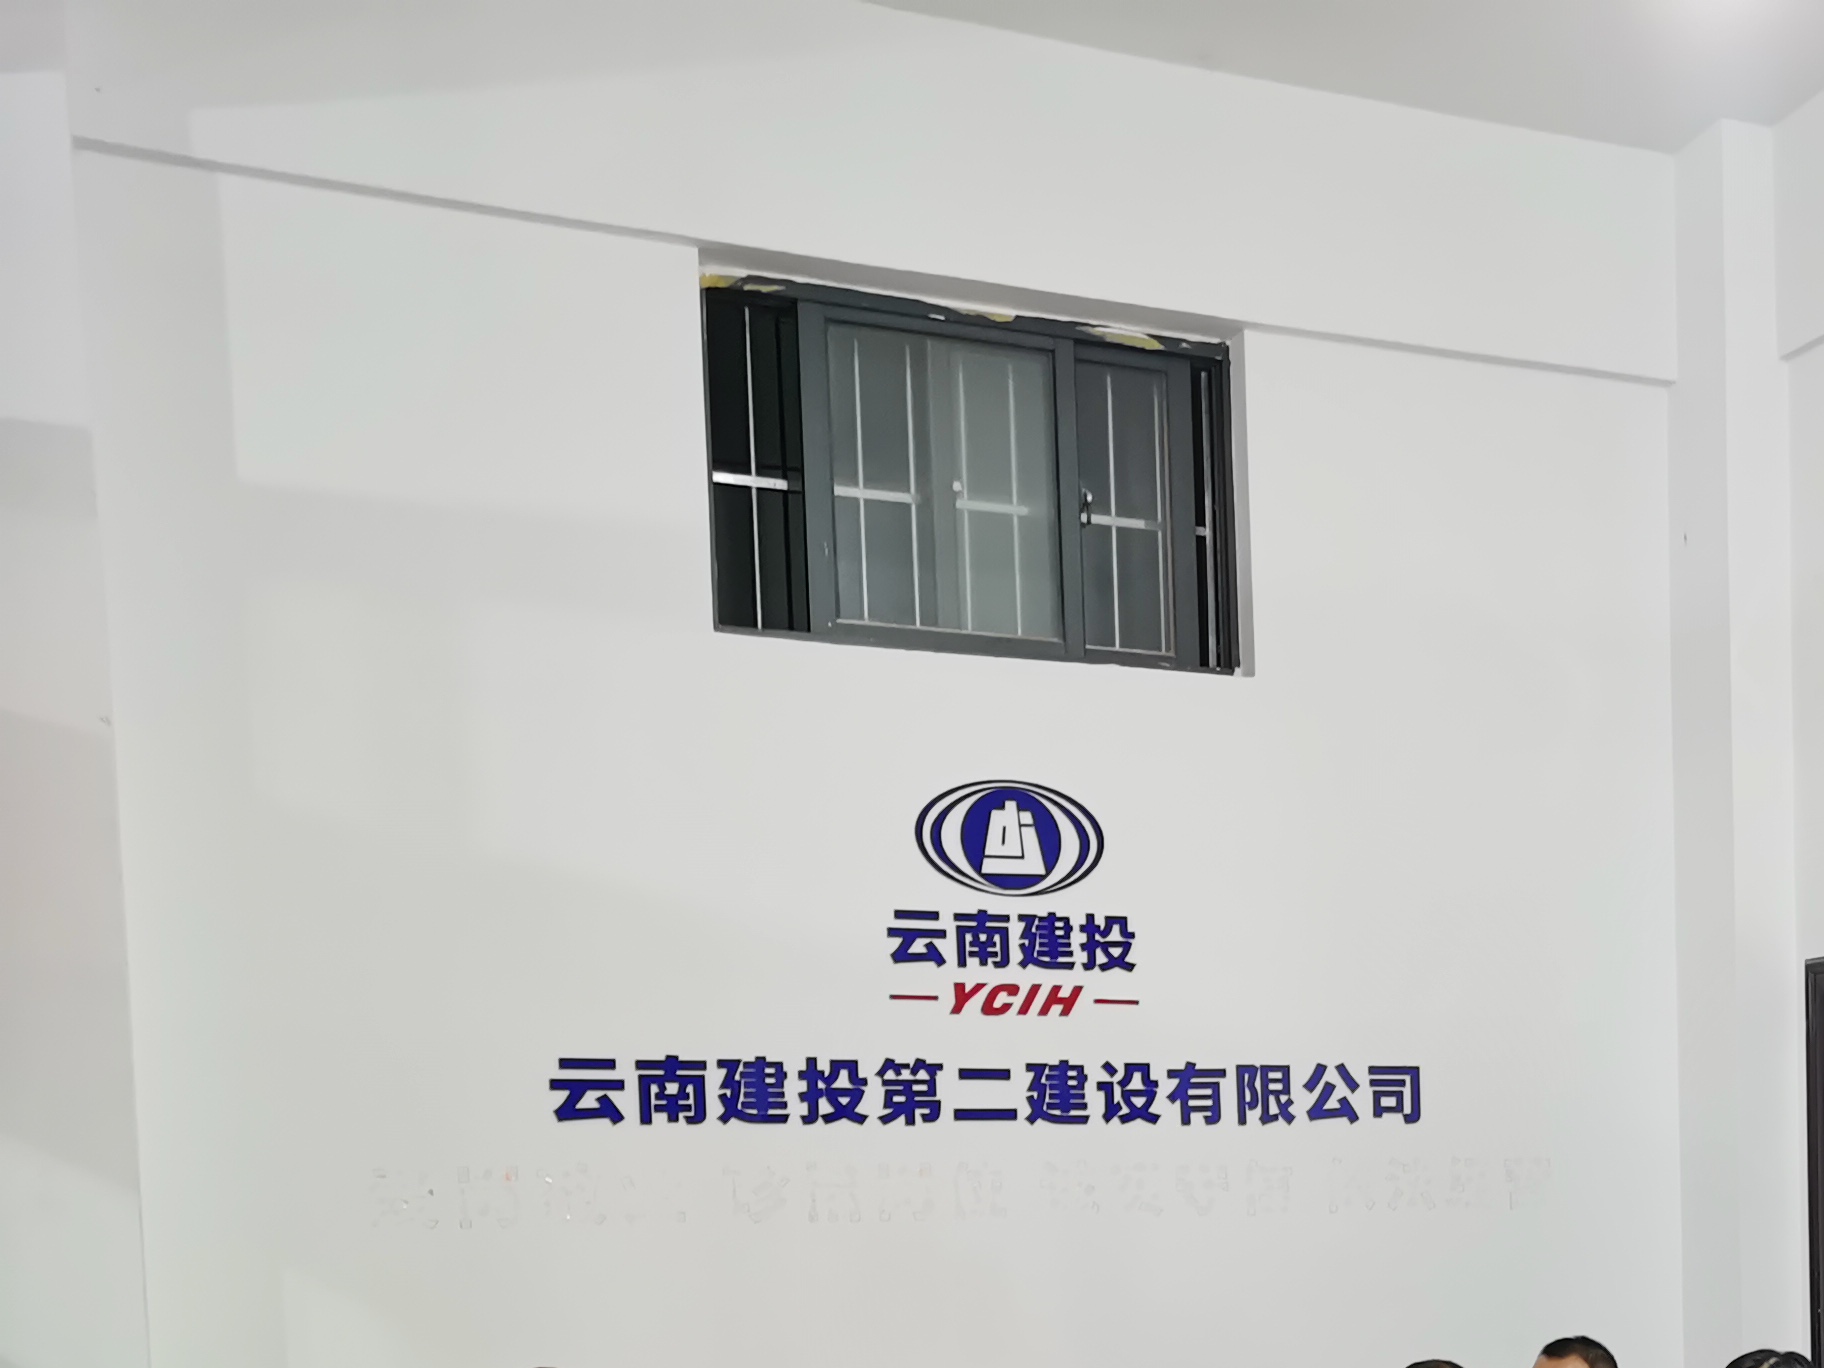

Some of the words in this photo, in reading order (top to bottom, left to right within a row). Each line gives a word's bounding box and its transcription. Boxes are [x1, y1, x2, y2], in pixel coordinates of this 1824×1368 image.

[886, 909, 1137, 973] 云南建投
[949, 982, 1084, 1017] YCIH
[549, 1054, 1422, 1127] 云南建投第二建设有限公司
